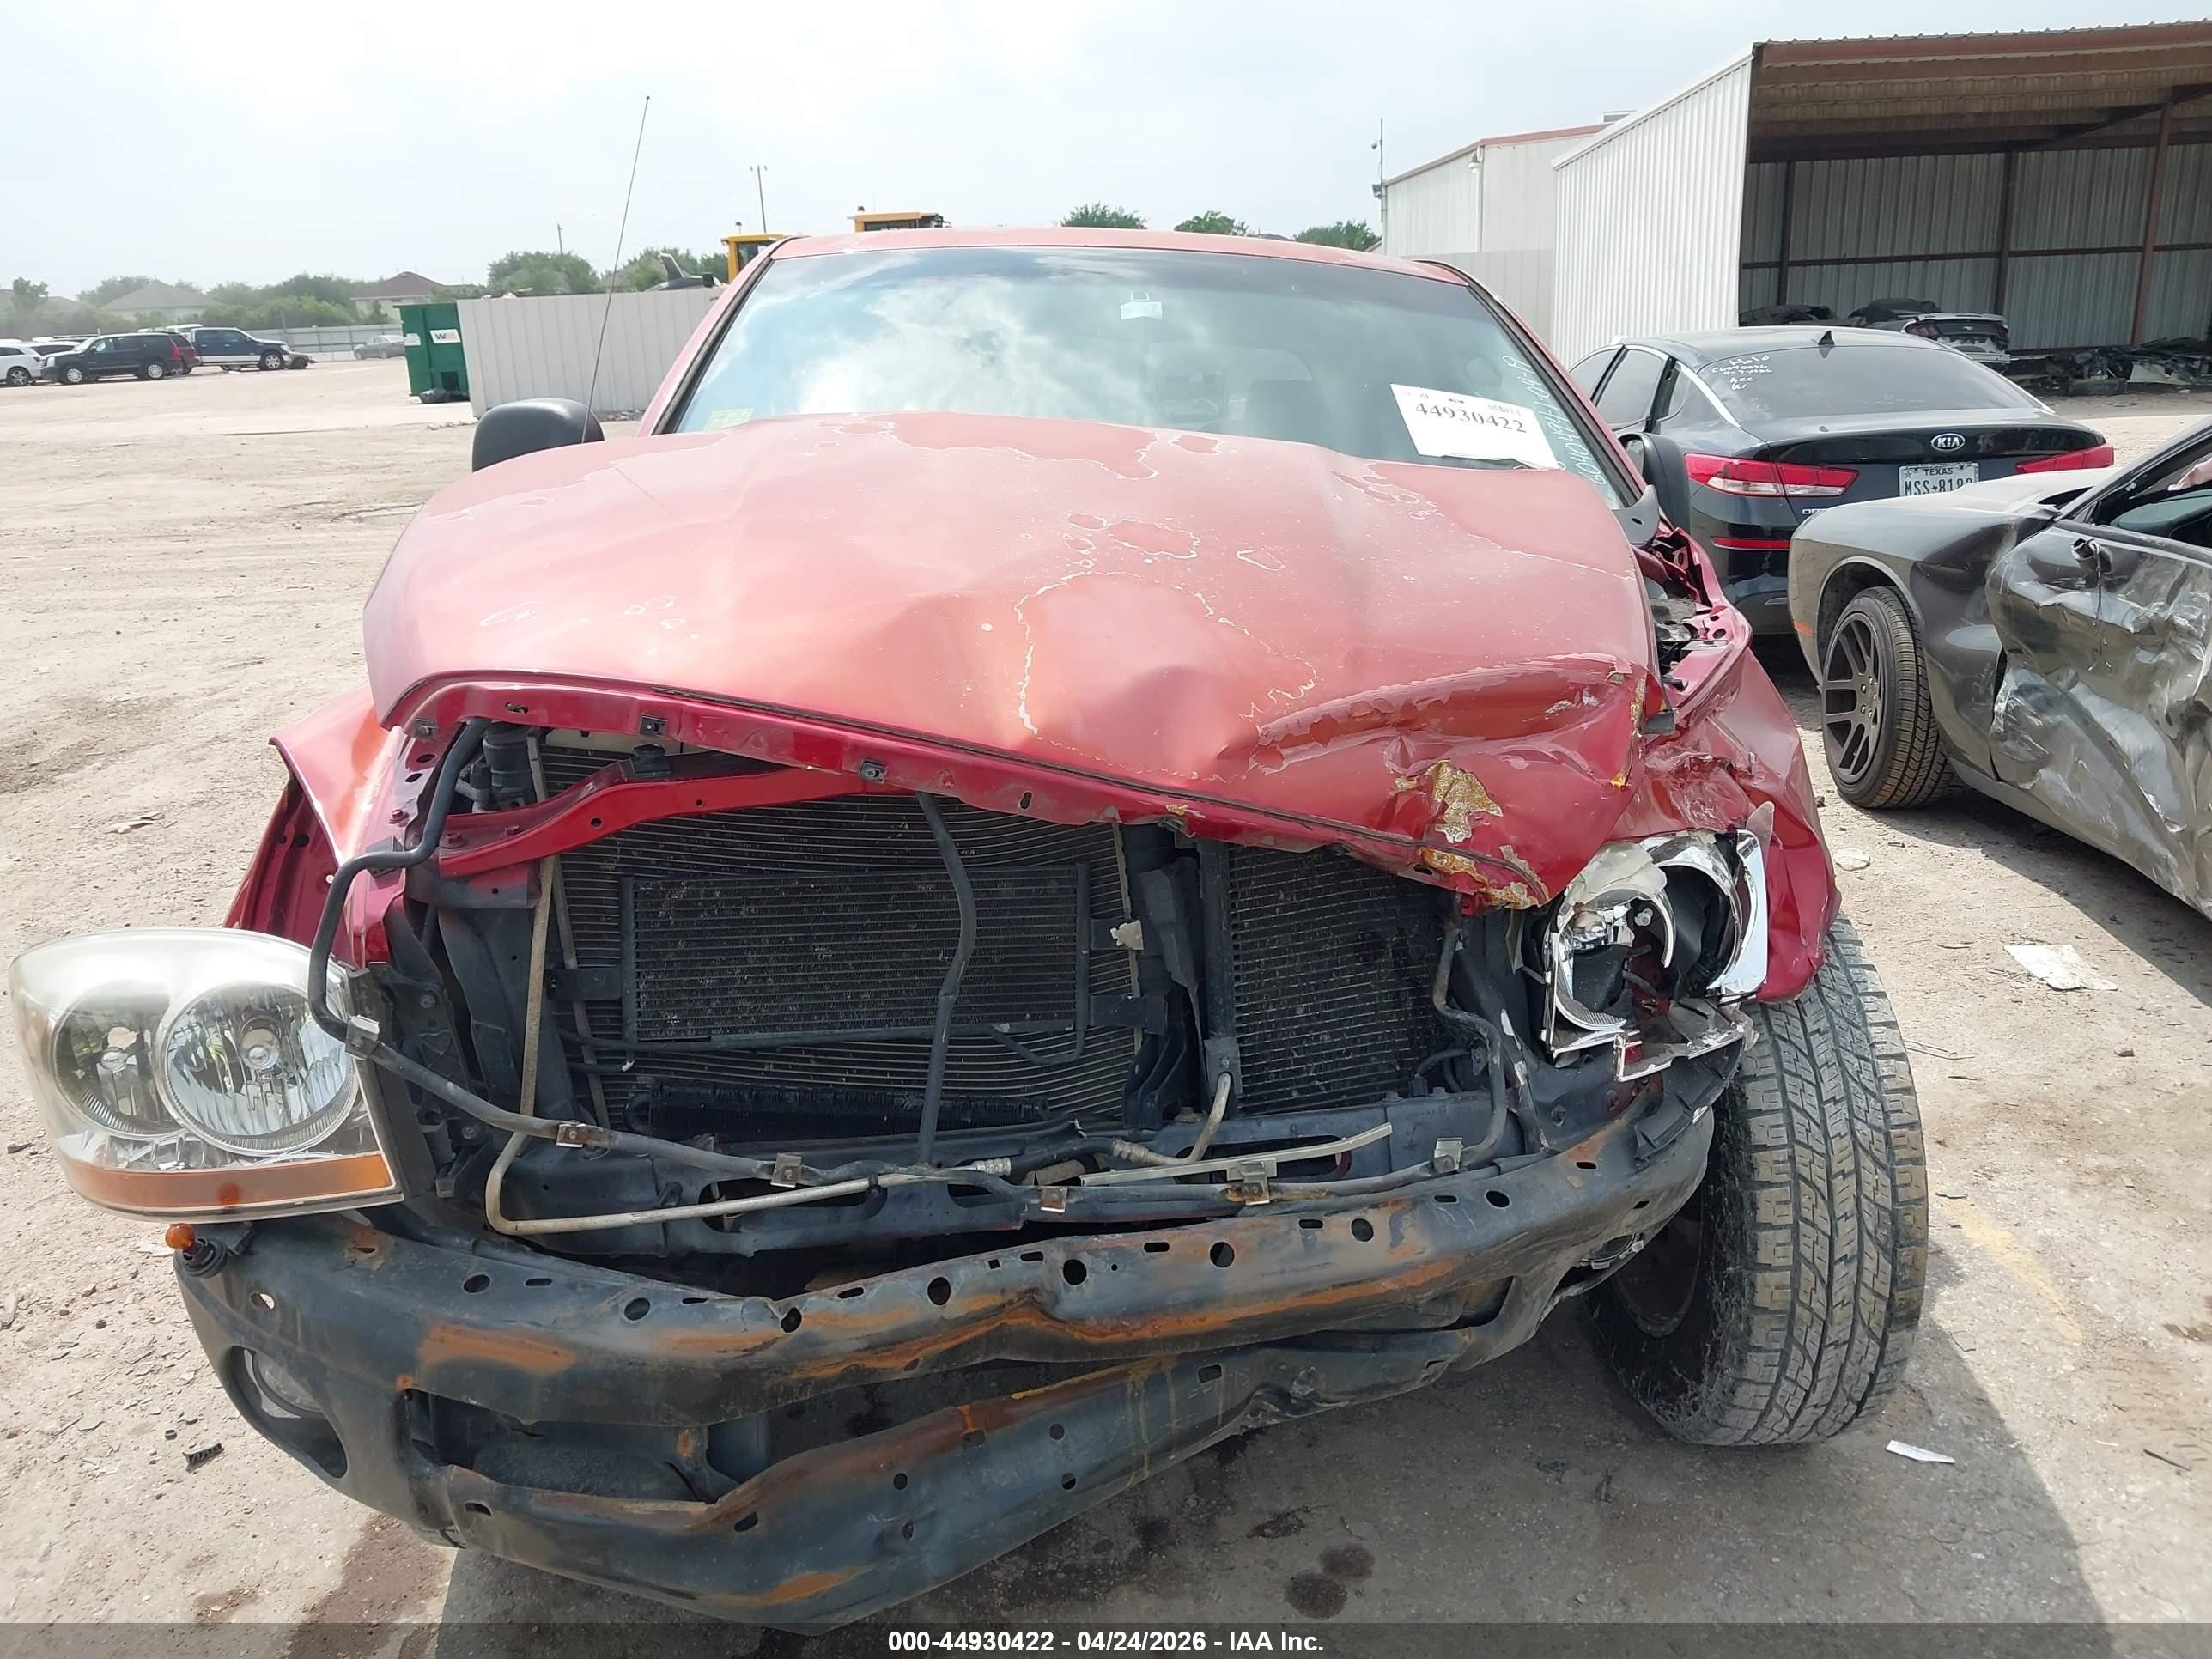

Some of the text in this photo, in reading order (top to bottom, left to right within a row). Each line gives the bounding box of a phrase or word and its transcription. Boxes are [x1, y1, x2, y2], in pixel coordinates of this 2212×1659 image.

[1415, 403, 1527, 434] 44930422
[1936, 436, 1960, 448] KIA
[1923, 467, 1954, 476] TEXAS
